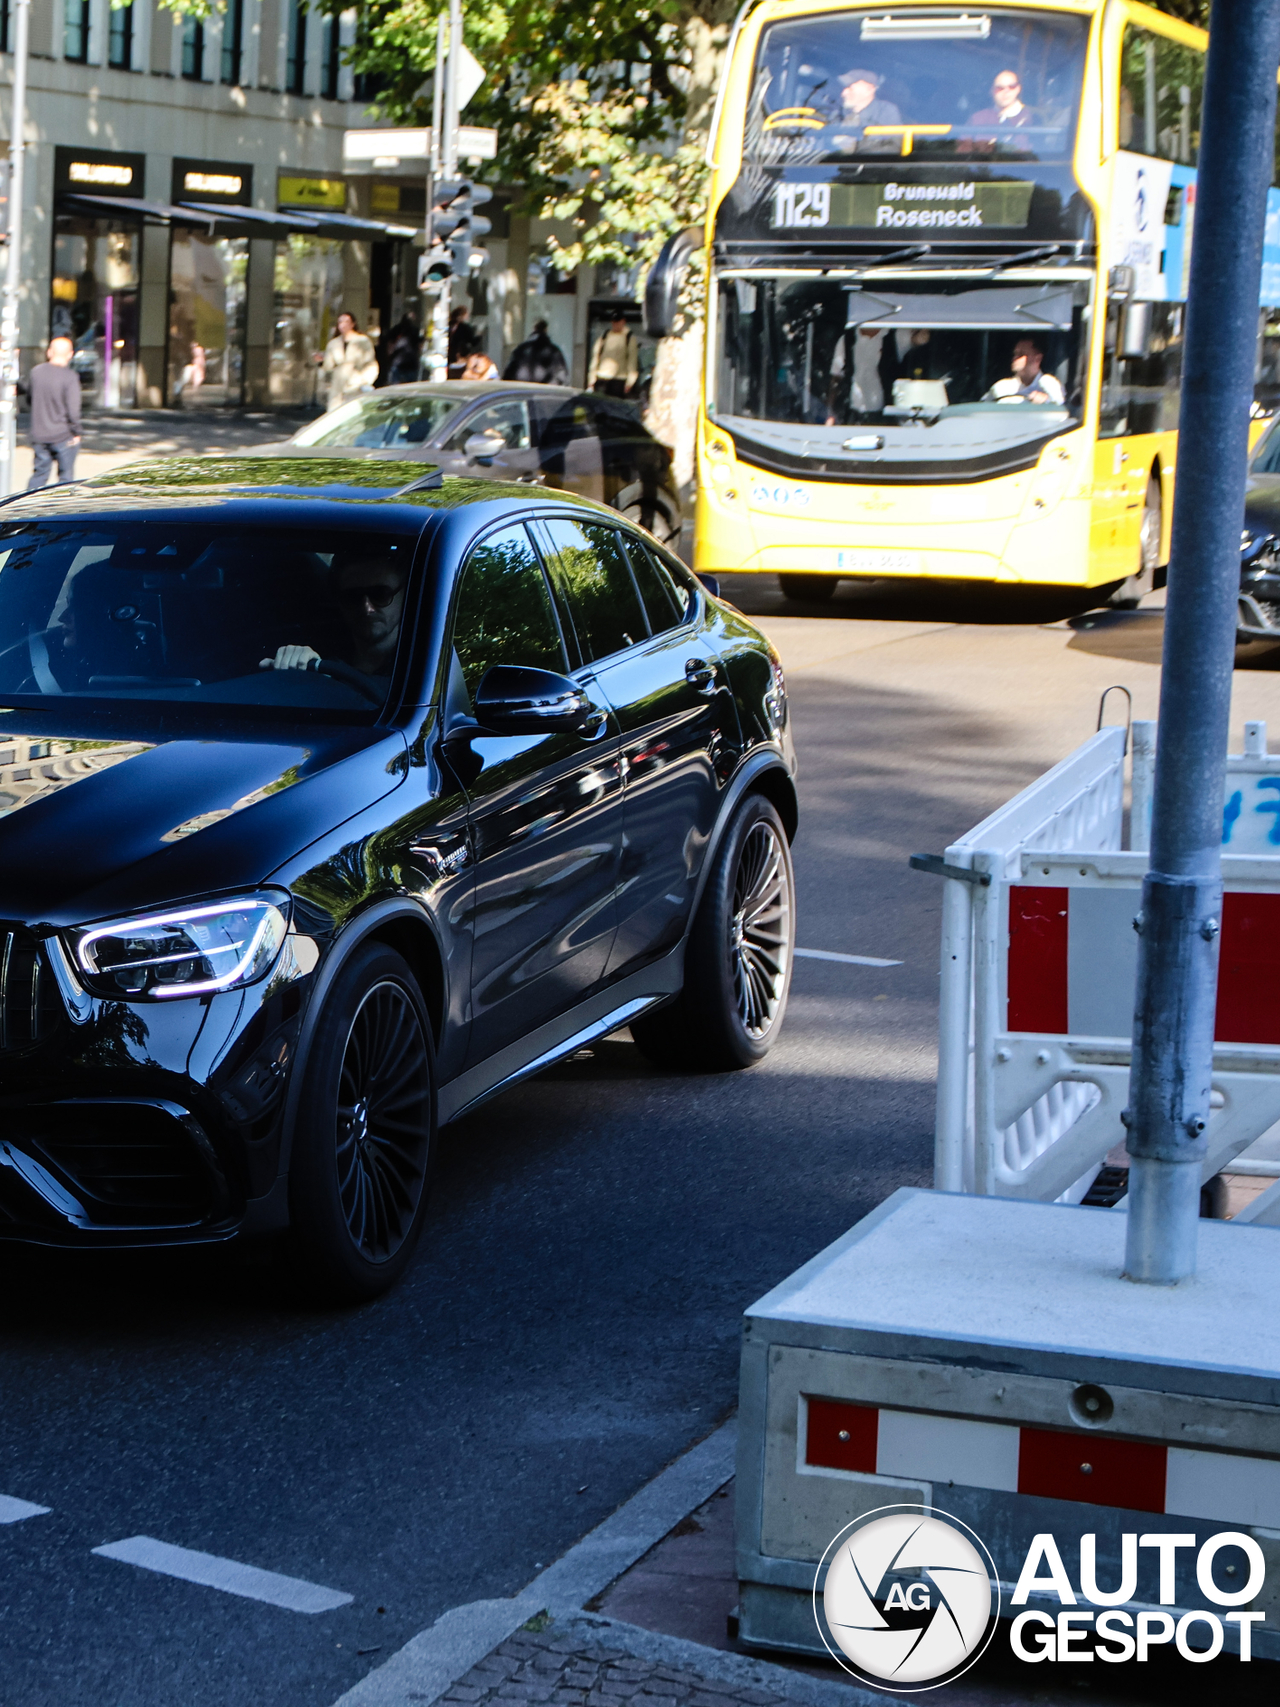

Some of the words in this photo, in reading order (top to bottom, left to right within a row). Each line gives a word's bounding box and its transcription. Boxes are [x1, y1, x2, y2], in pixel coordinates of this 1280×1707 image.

[884, 181, 975, 201] Grunewald
[773, 182, 832, 228] M29
[875, 205, 983, 228] Roseneck
